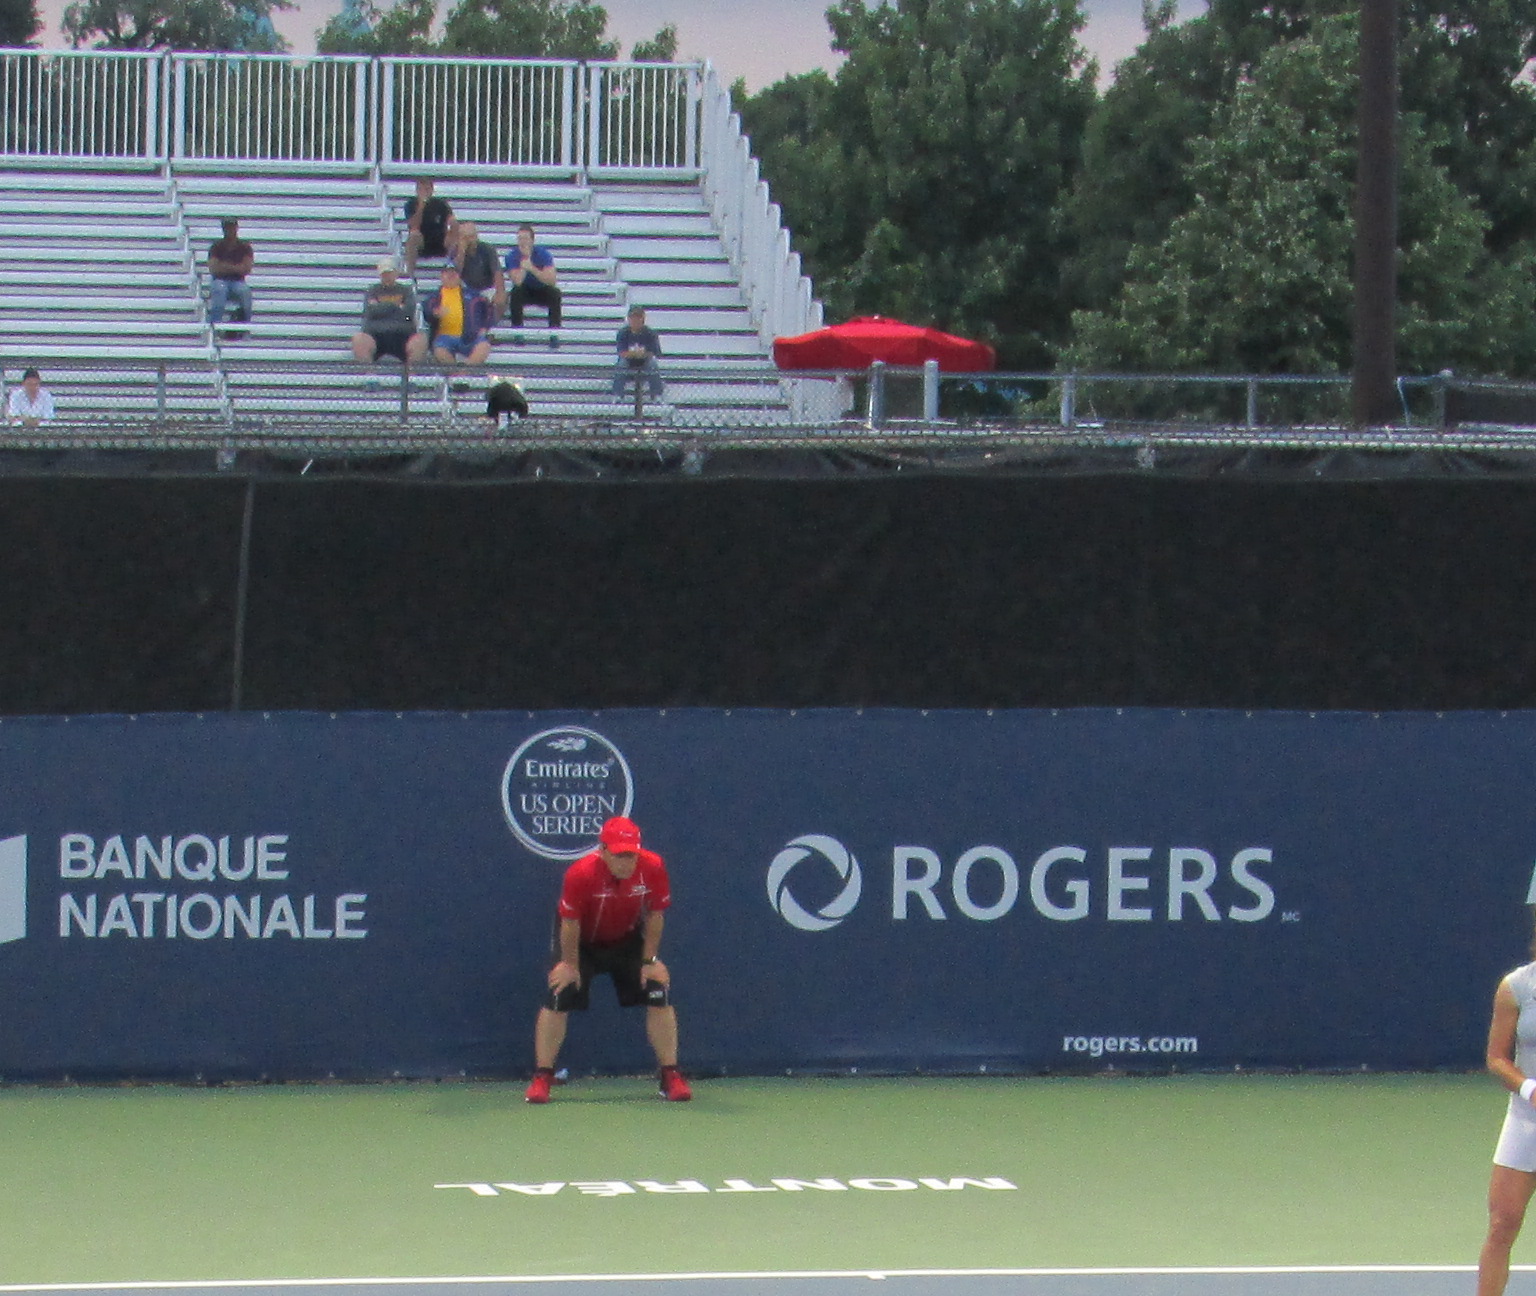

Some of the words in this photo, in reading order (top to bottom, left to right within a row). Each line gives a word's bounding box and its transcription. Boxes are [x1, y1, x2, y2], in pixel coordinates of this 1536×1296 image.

[525, 759, 609, 778] Emirates
[520, 794, 548, 814] US
[552, 794, 616, 814] OPEN
[532, 815, 604, 835] SERIES
[60, 833, 290, 882] BANQUE
[892, 845, 1276, 923] ROGERS
[59, 892, 369, 940] NATIONALE
[1063, 1036, 1199, 1057] rogers.com
